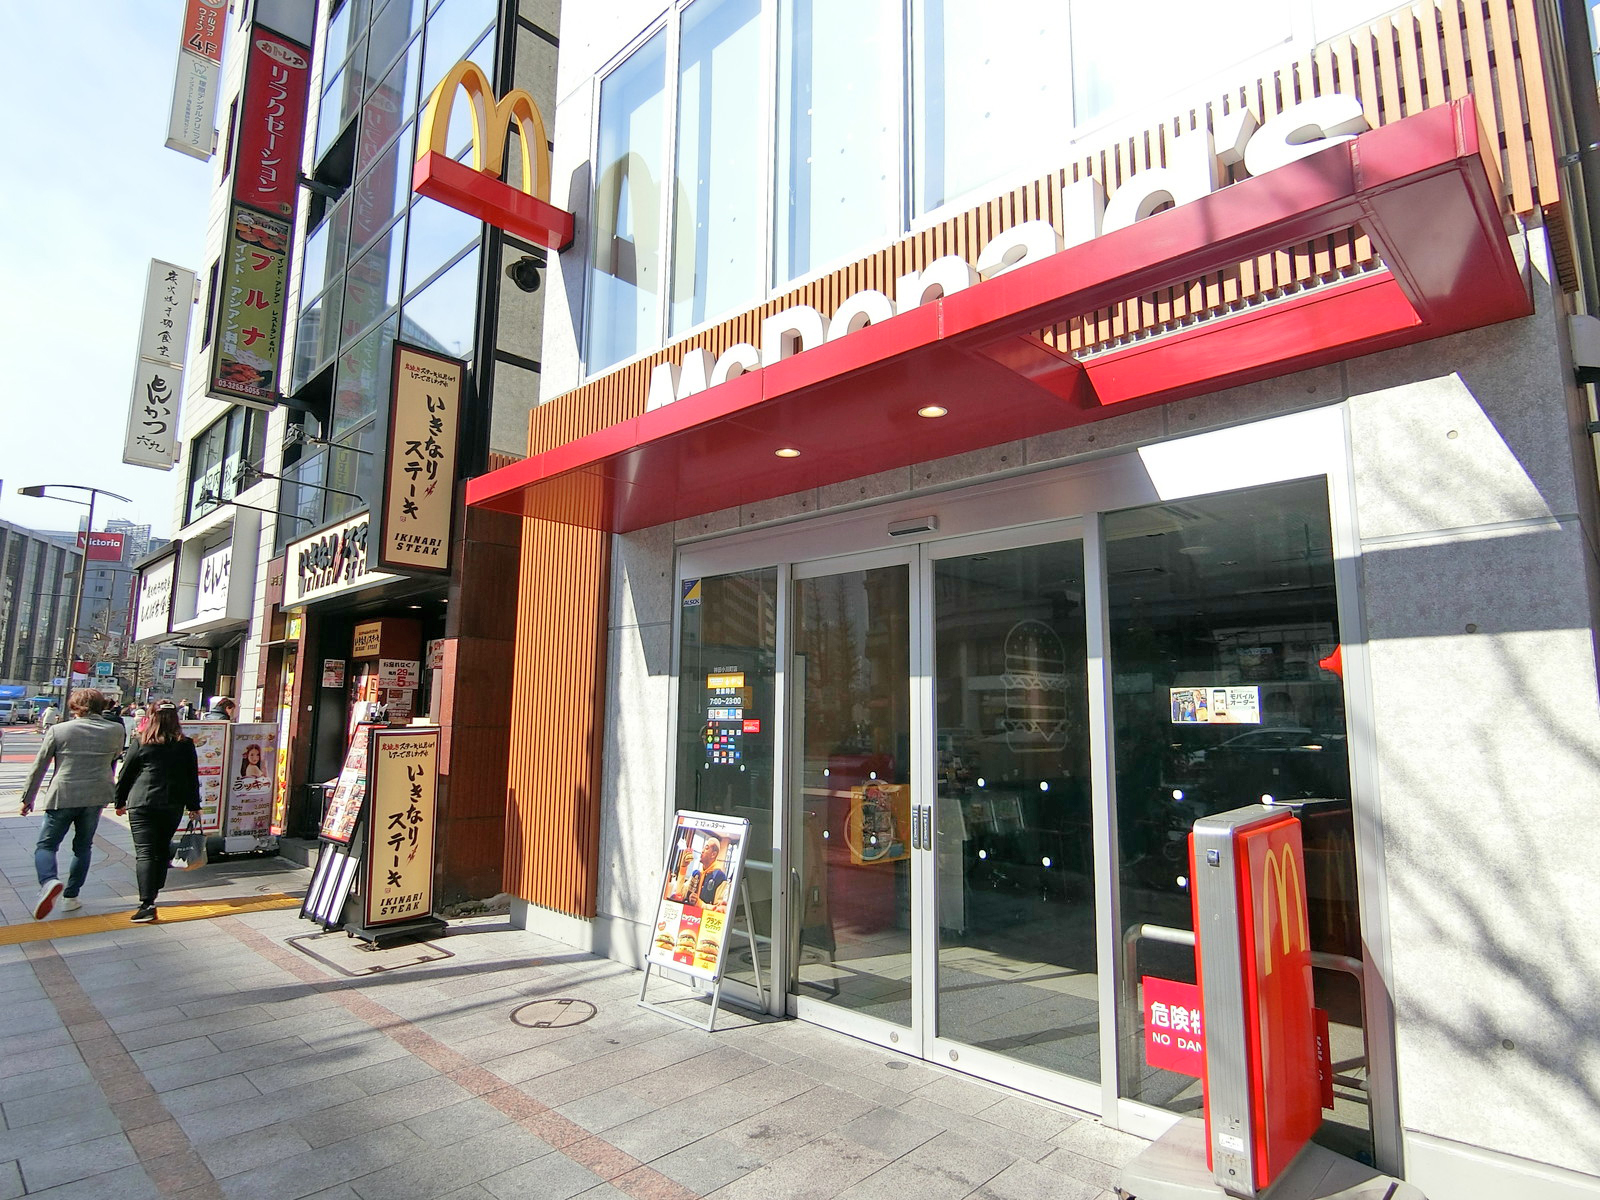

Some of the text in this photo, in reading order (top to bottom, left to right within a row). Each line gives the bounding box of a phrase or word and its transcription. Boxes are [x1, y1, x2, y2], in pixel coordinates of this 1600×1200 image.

[188, 33, 217, 55] 4F
[257, 65, 289, 193] リラクゼーション
[646, 93, 1370, 414] McDonald's
[242, 251, 275, 346] プルナ
[143, 374, 173, 436] とんかつ
[424, 394, 446, 482] いきなり
[402, 440, 425, 520] ステーキ
[394, 532, 443, 547] IKINARI
[396, 542, 440, 556] STEAK
[406, 764, 424, 846] いきなり
[387, 812, 406, 888] ステーキ
[380, 892, 423, 907] IKINARI
[380, 903, 420, 916] STEAK
[1152, 1031, 1171, 1045] NO
